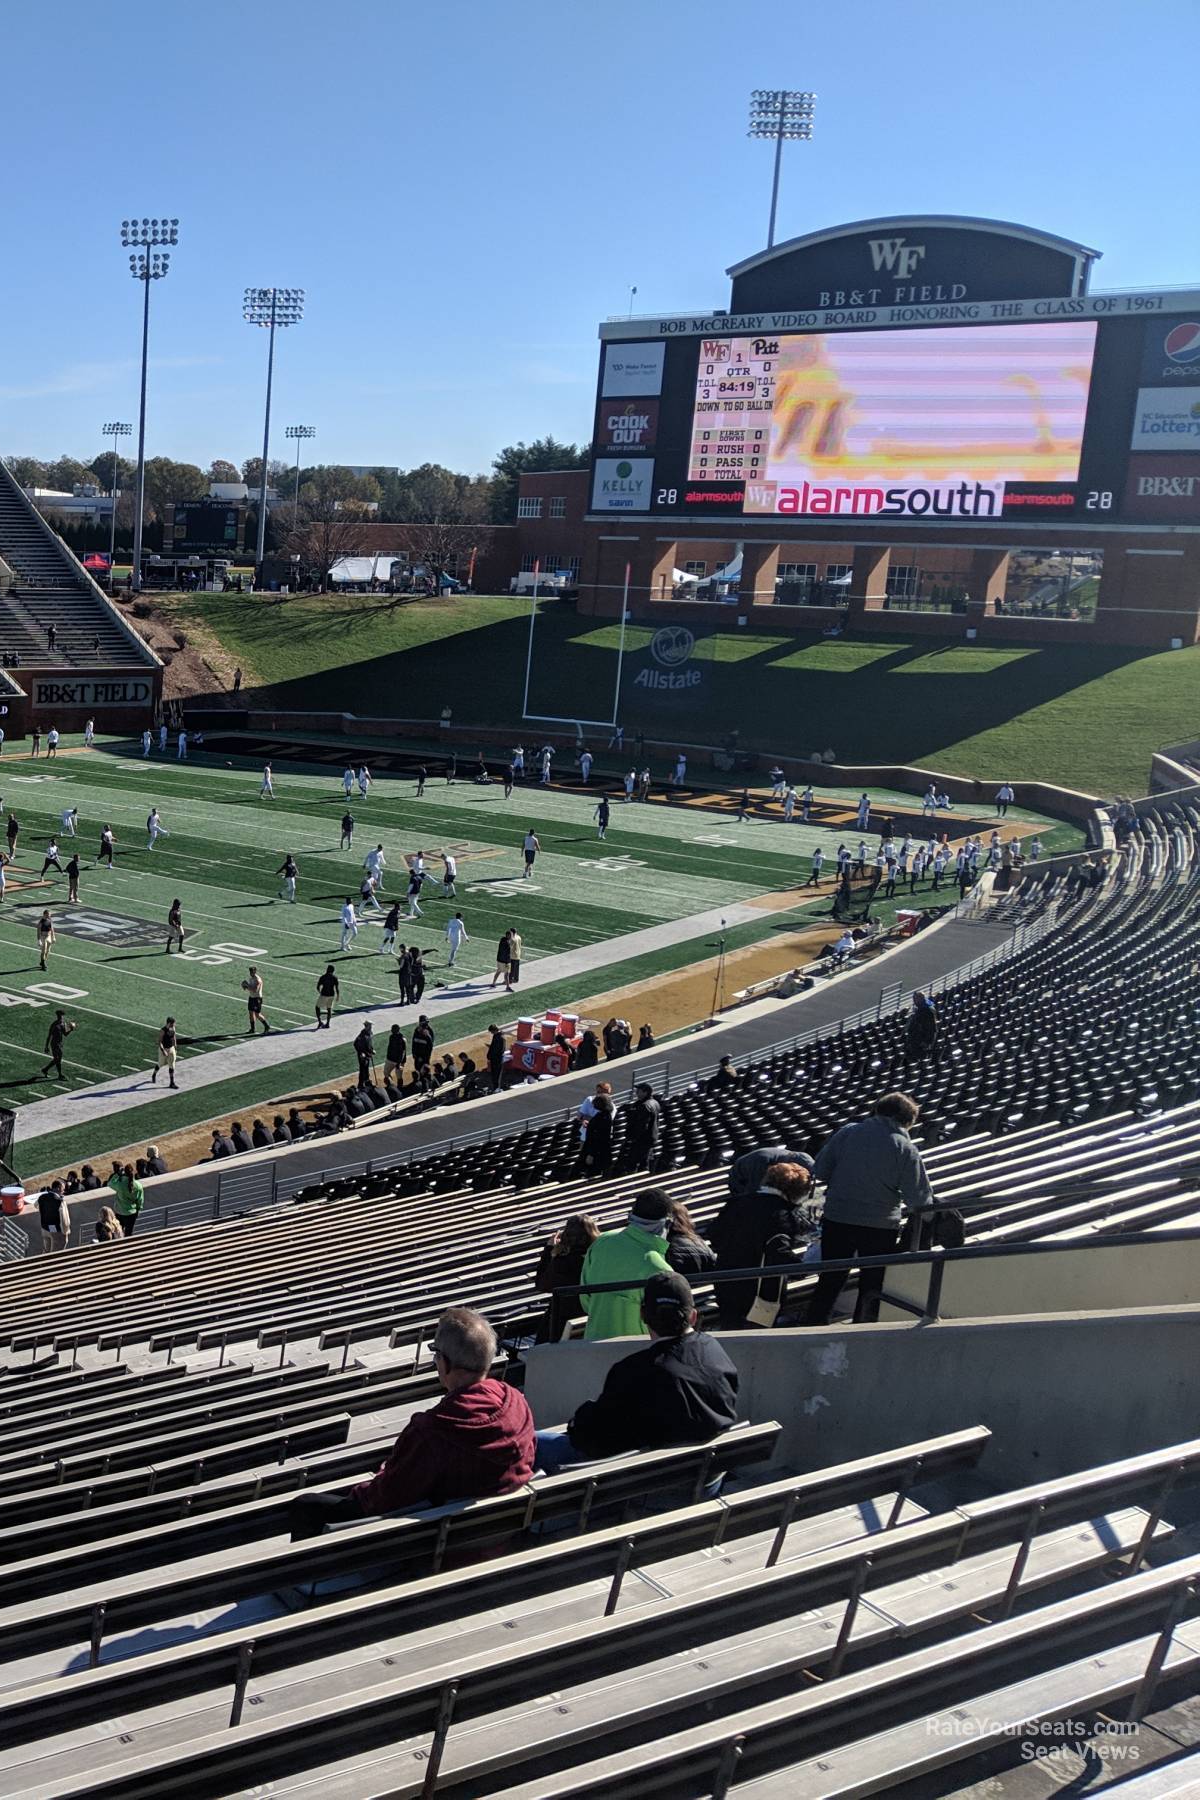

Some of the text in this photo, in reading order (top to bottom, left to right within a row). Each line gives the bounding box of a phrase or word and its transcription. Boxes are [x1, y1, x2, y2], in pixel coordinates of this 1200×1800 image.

[868, 237, 926, 280] WF
[819, 284, 968, 307] BB&T FIELD
[659, 296, 1164, 334] BOB McCREARY VIDEO BOARD HONORING THE CLASS OF 1961
[751, 338, 780, 356] Pitt
[706, 364, 714, 375] 0
[726, 367, 751, 377] QTR
[763, 361, 771, 372] 0
[1162, 366, 1200, 379] peps
[718, 381, 755, 392] 84:19
[761, 387, 769, 398] 3
[702, 389, 710, 399] 3
[697, 402, 721, 412] DOWN
[724, 401, 733, 411] TO
[747, 400, 763, 411] BALL
[764, 400, 773, 410] ON
[607, 415, 649, 429] COOK
[1140, 419, 1200, 437] Lottery
[613, 429, 643, 443] OUT
[716, 444, 744, 454] RUSH
[715, 457, 743, 467] PASS
[714, 470, 742, 479] TOTAL
[602, 479, 643, 492] KELLY
[1137, 476, 1200, 497] BB&T
[657, 489, 677, 504] 28
[685, 491, 745, 502] alarmsouth
[778, 480, 996, 515] alarmsouth
[1003, 492, 1075, 506] alarmsouth
[1086, 491, 1113, 509] 28
[633, 668, 702, 689] Allstate
[36, 682, 149, 704] BB&T FIELD
[175, 942, 269, 965] 50
